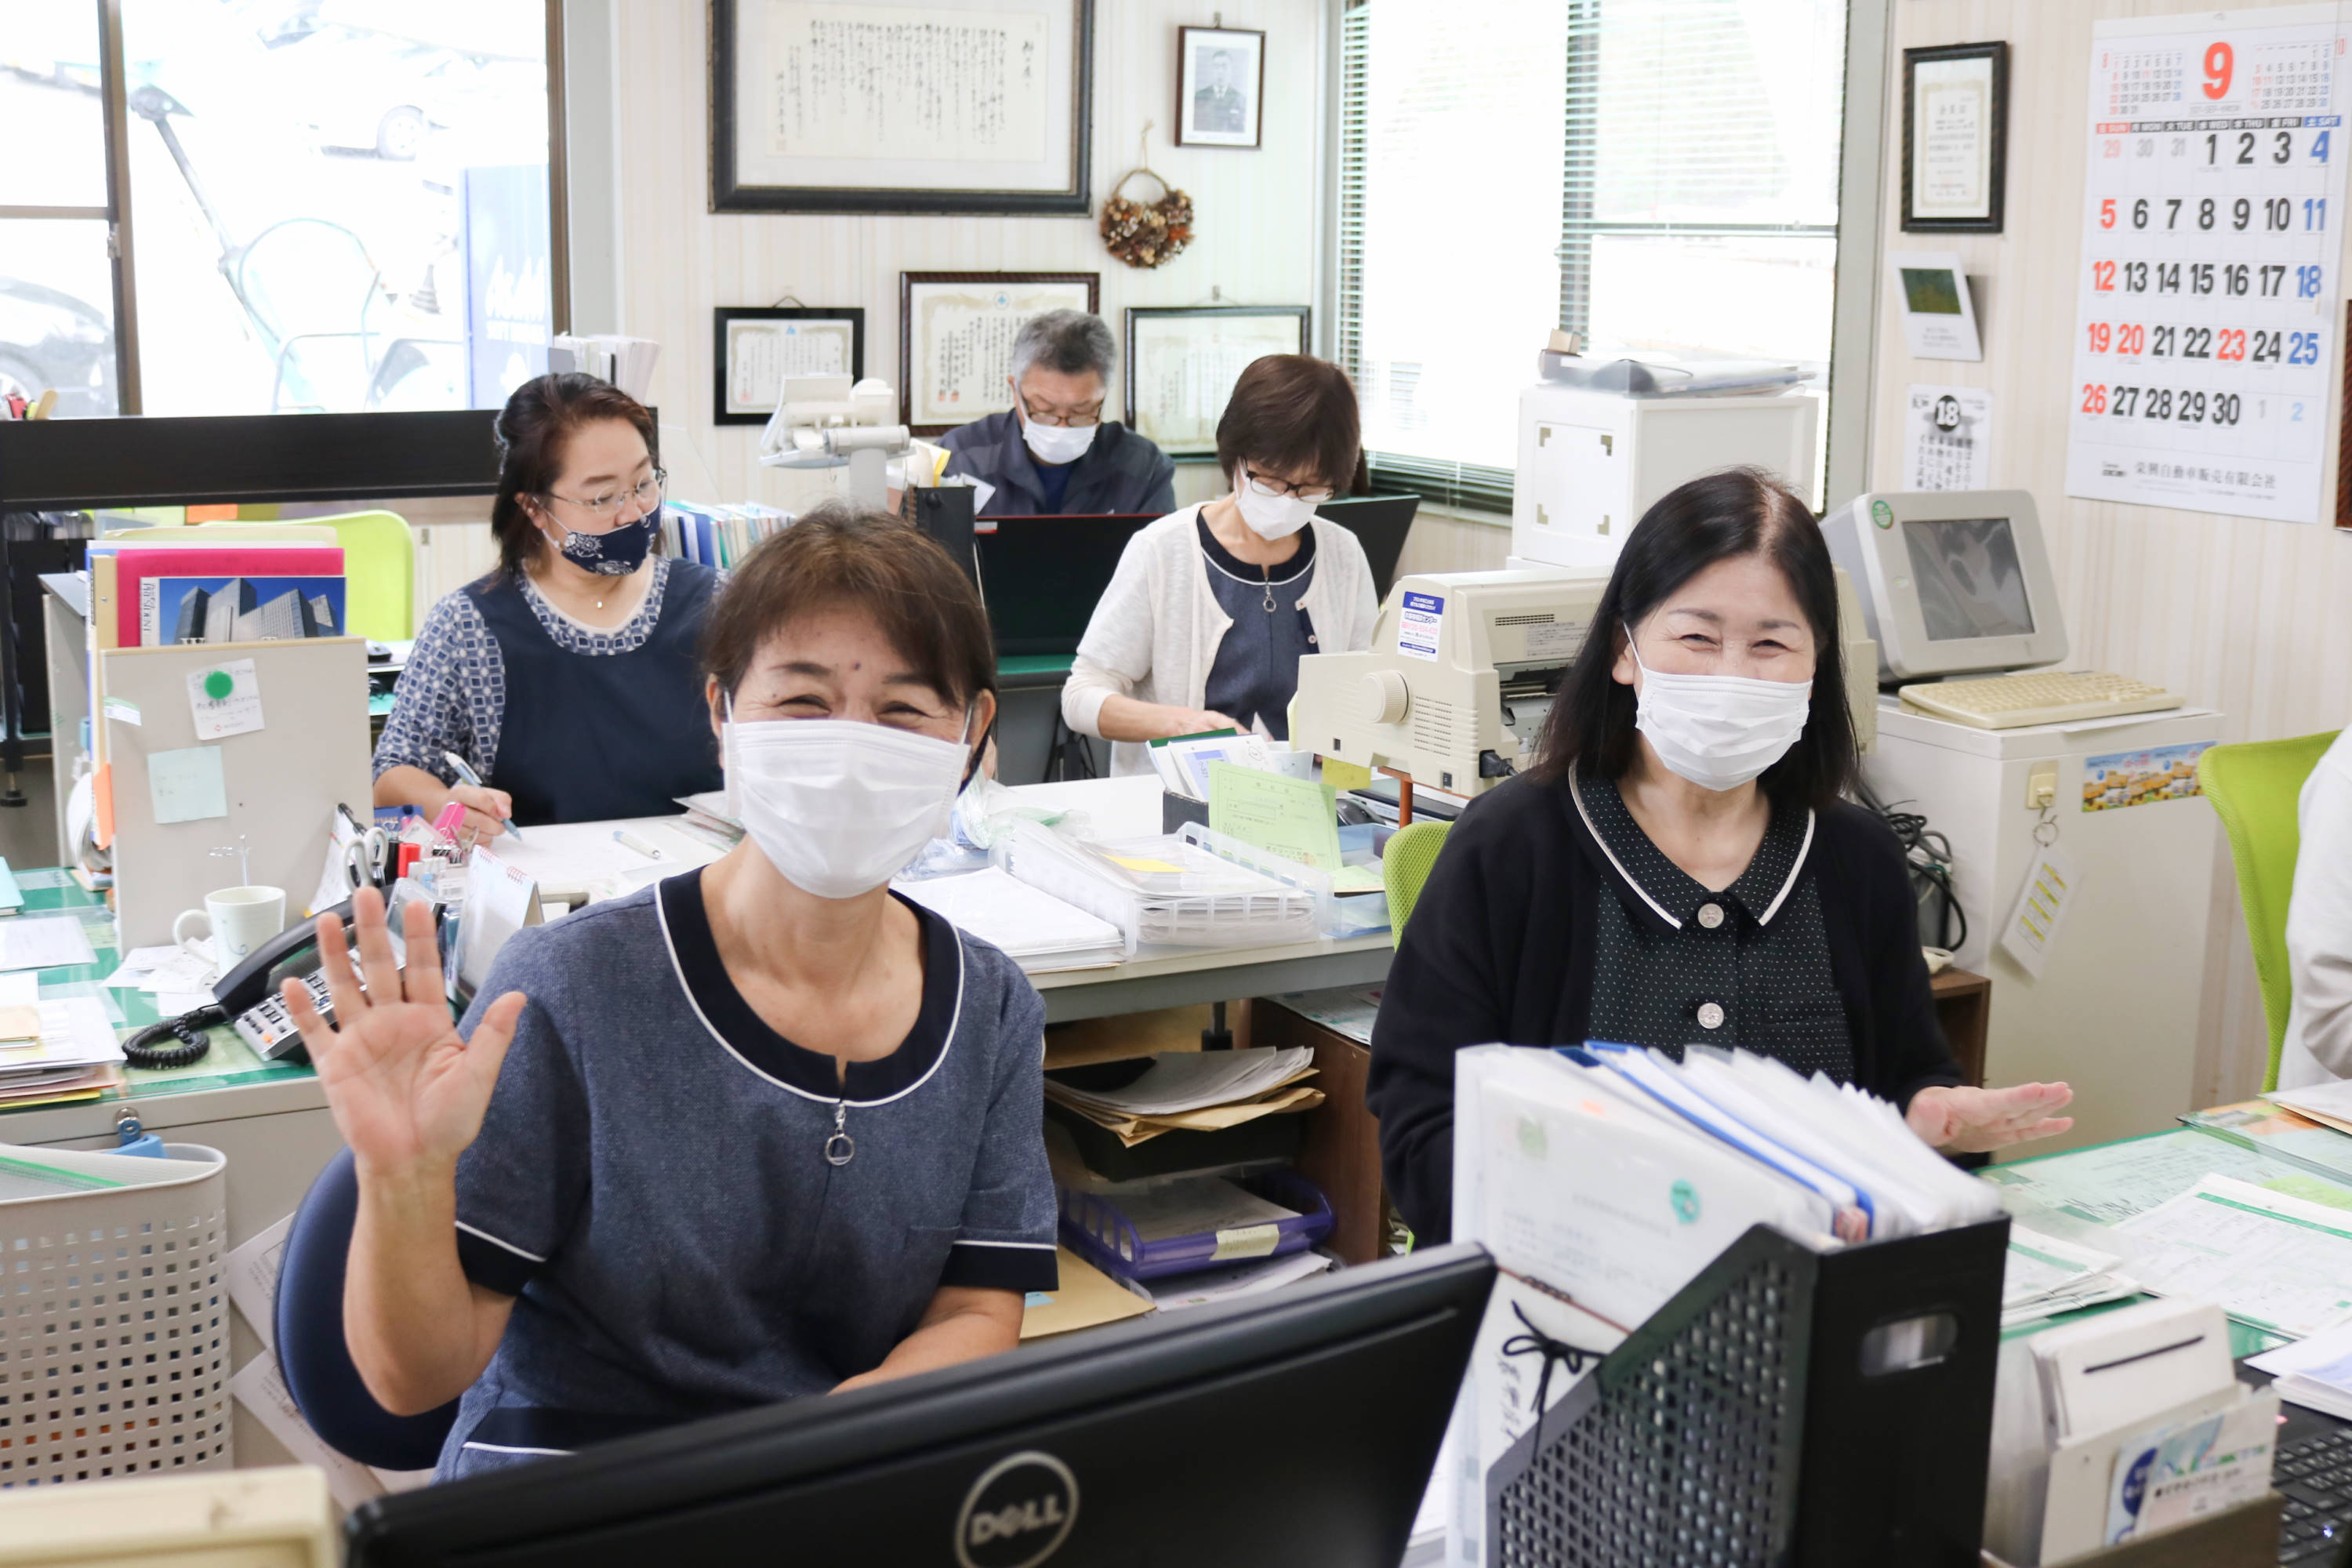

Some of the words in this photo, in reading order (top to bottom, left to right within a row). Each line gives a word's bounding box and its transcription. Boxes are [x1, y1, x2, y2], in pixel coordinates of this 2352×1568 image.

[2203, 42, 2233, 100] 9
[2176, 121, 2194, 131] TUE
[2244, 118, 2263, 129] THU
[2282, 118, 2299, 129] FRI
[2319, 116, 2336, 127] SAT
[2104, 139, 2121, 158] 29
[2136, 138, 2154, 157] 30
[2171, 137, 2186, 157] 31
[2207, 134, 2216, 164] 1
[2238, 132, 2255, 164] 2
[2274, 132, 2291, 164] 3
[2311, 131, 2329, 162] 4
[2101, 199, 2115, 228] 5
[2133, 199, 2148, 229] 6
[2167, 199, 2182, 229] 7
[2199, 198, 2214, 230] 8
[2234, 198, 2250, 230] 9
[2266, 198, 2290, 230] 10
[2304, 199, 2325, 230] 11
[2094, 261, 2115, 290] 12
[2125, 262, 2147, 292] 13
[2158, 263, 2180, 292] 14
[2190, 263, 2214, 294] 15
[2225, 264, 2249, 296] 16
[2260, 265, 2285, 296] 17
[2297, 266, 2321, 297] 18
[2089, 323, 2110, 352] 19
[2118, 324, 2143, 354] 20
[2153, 325, 2174, 356] 21
[2183, 327, 2211, 358] 22
[2218, 329, 2245, 361] 23
[2252, 331, 2281, 362] 24
[2288, 332, 2318, 365] 25
[1936, 401, 1958, 426] 18
[2082, 384, 2106, 414] 26
[2112, 386, 2139, 416] 27
[2145, 388, 2172, 419] 28
[2178, 390, 2205, 422] 29
[2212, 393, 2240, 425] 30
[2259, 400, 2267, 418] 1
[2291, 402, 2304, 421] 2
[971, 1494, 1065, 1546] DELL
